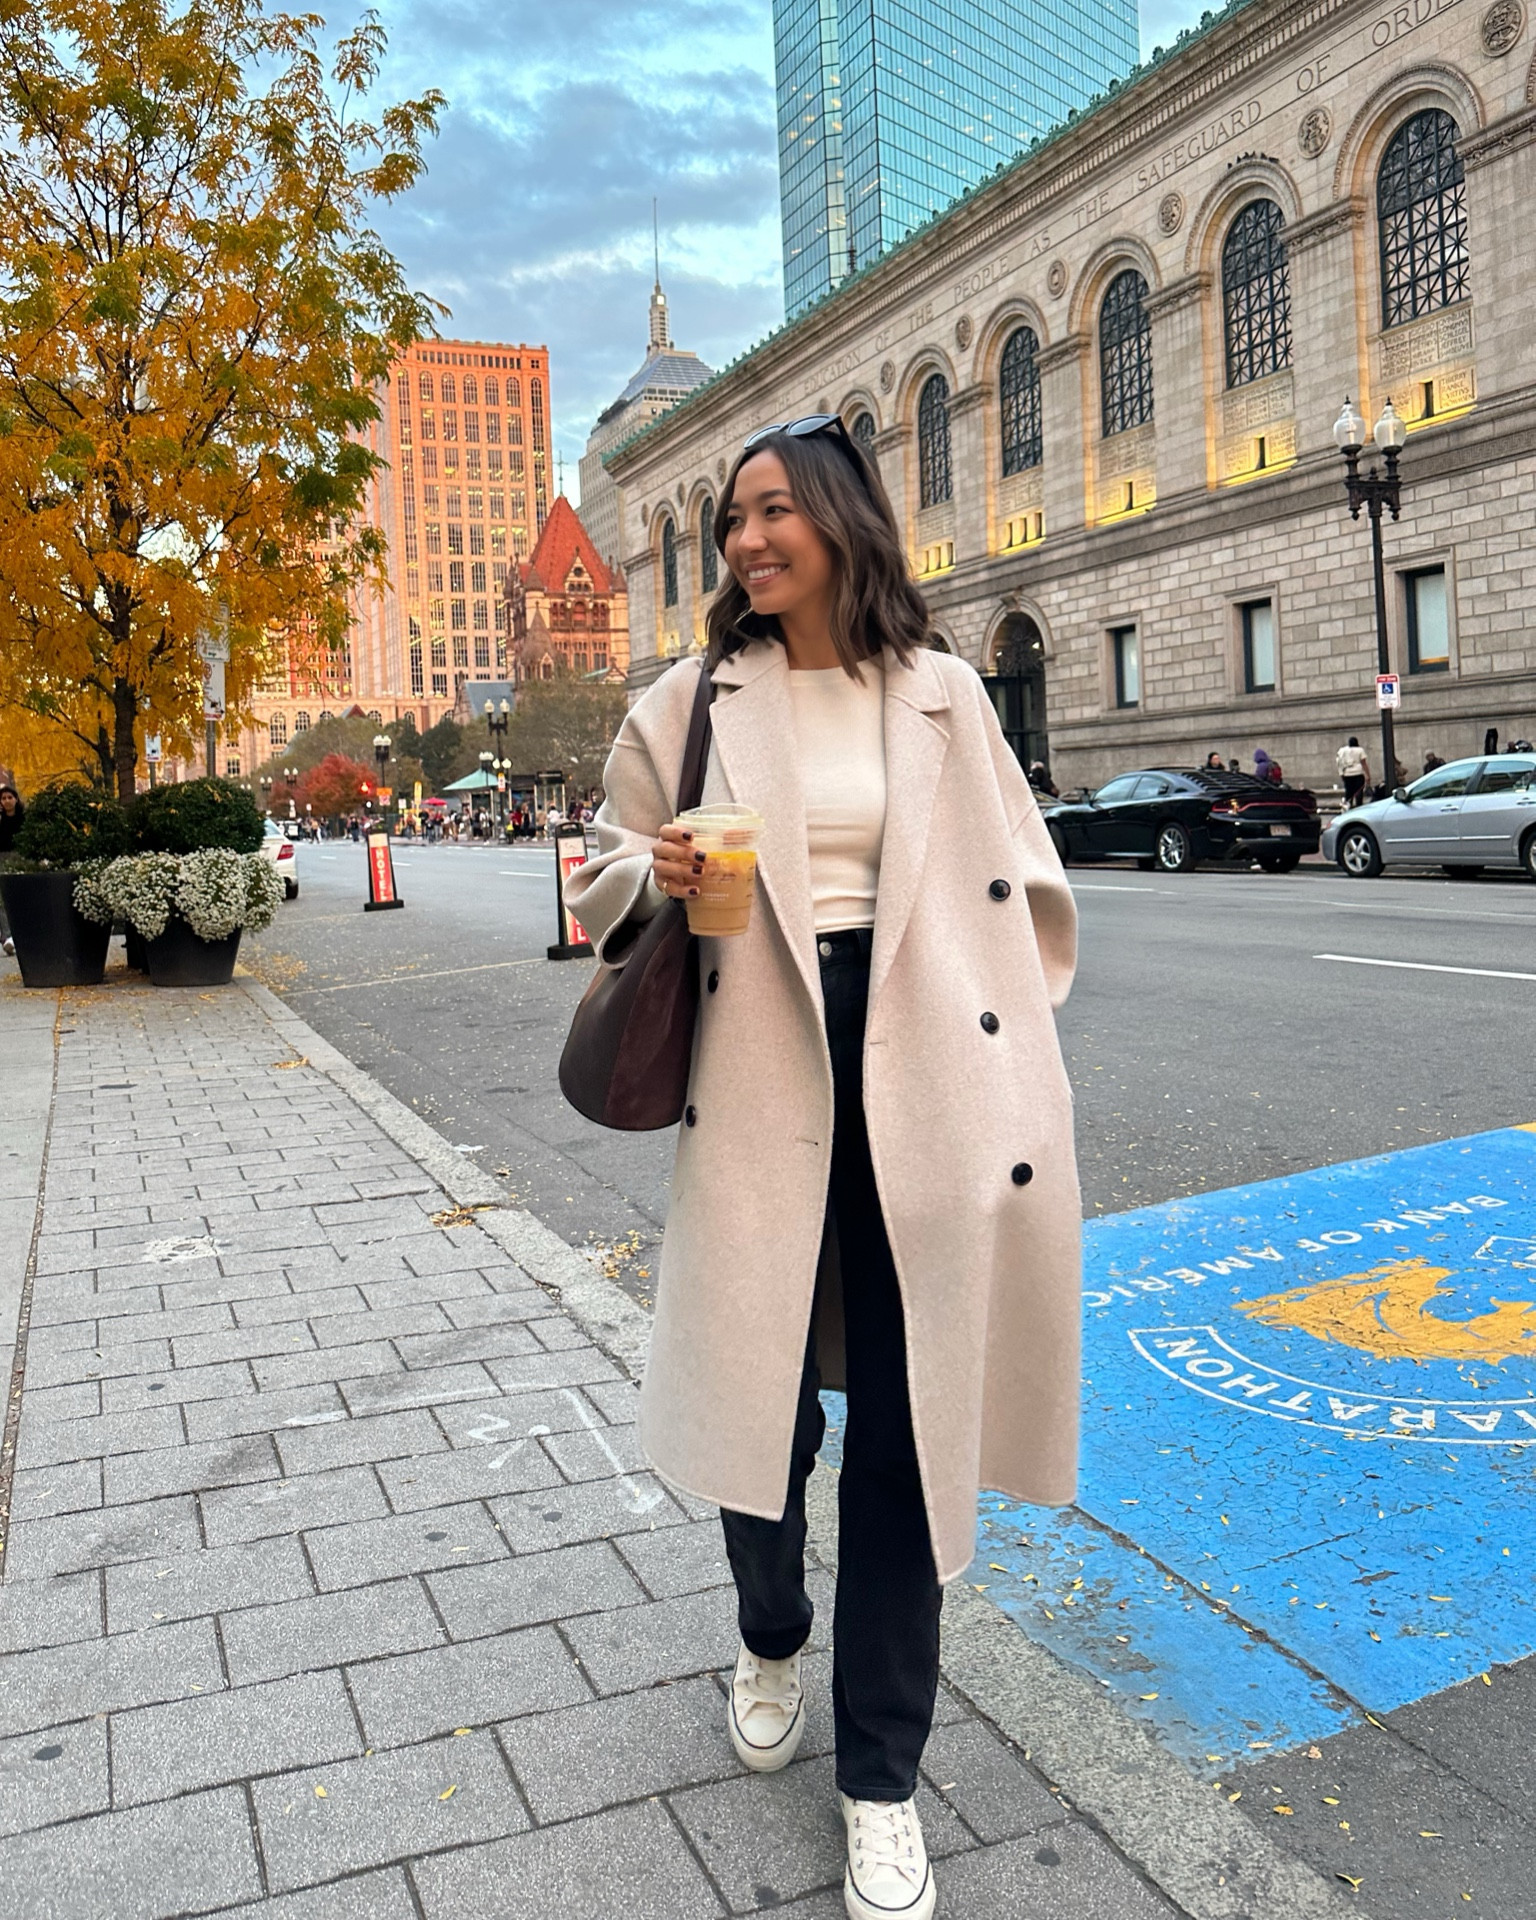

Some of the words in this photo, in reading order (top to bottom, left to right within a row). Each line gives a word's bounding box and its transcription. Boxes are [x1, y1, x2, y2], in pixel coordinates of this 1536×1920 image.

[804, 348, 862, 394] EDUCATION
[875, 328, 894, 352] OF
[907, 302, 934, 331] THE
[953, 256, 1010, 302] PEOPLE
[1030, 232, 1051, 258] AS
[1073, 192, 1111, 227] THE
[1138, 100, 1262, 191] SAFEGUARD
[1296, 54, 1331, 93] OF
[375, 848, 387, 901] HOTEL
[1361, 1195, 1508, 1230] BANK
[1297, 1229, 1363, 1253] OF
[1082, 1245, 1285, 1307] AMERIC
